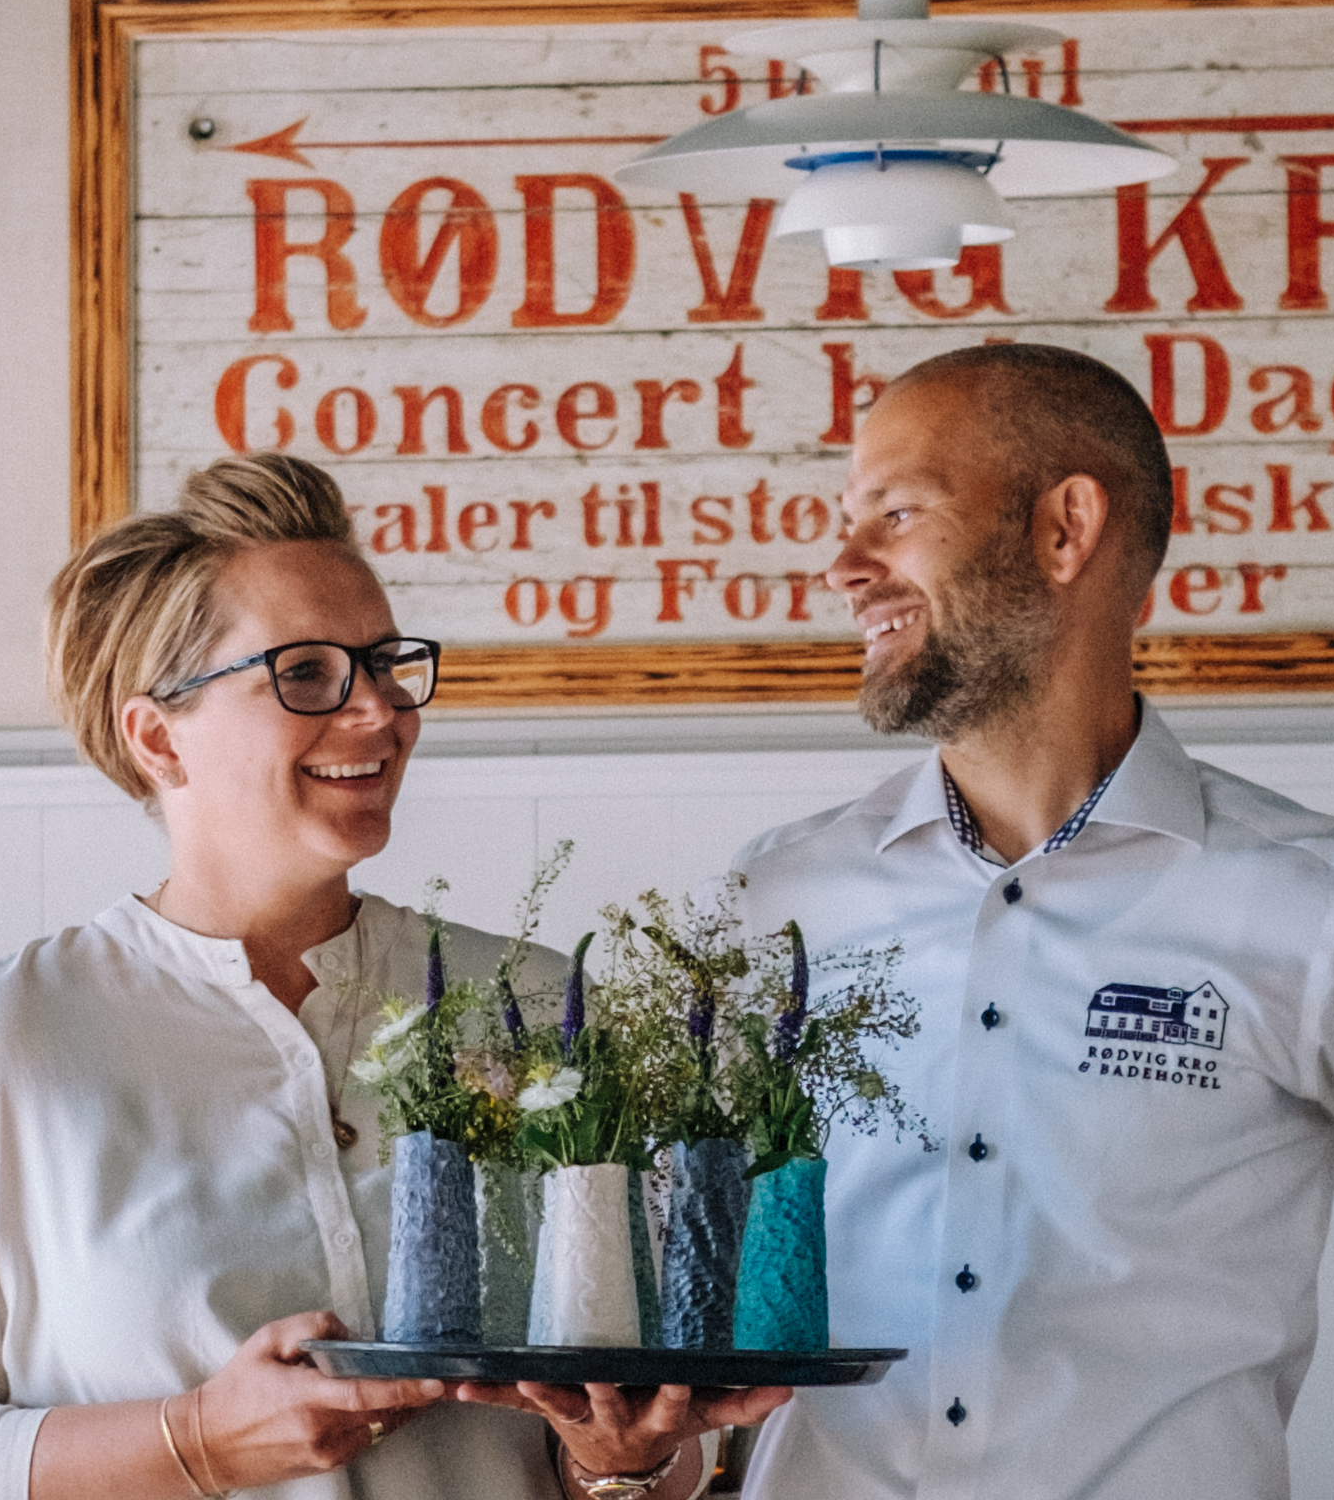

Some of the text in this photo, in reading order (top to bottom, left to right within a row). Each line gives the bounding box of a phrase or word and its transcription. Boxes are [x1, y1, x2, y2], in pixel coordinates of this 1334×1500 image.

[698, 45, 741, 118] 5
[214, 342, 754, 456] Concert
[346, 485, 557, 555] aler
[580, 481, 662, 548] til
[690, 478, 848, 546] stø
[504, 574, 616, 638] og
[1078, 1060, 1222, 1090] & BADEHOTEL
[1088, 1046, 1218, 1072] RØDVIG KRO
